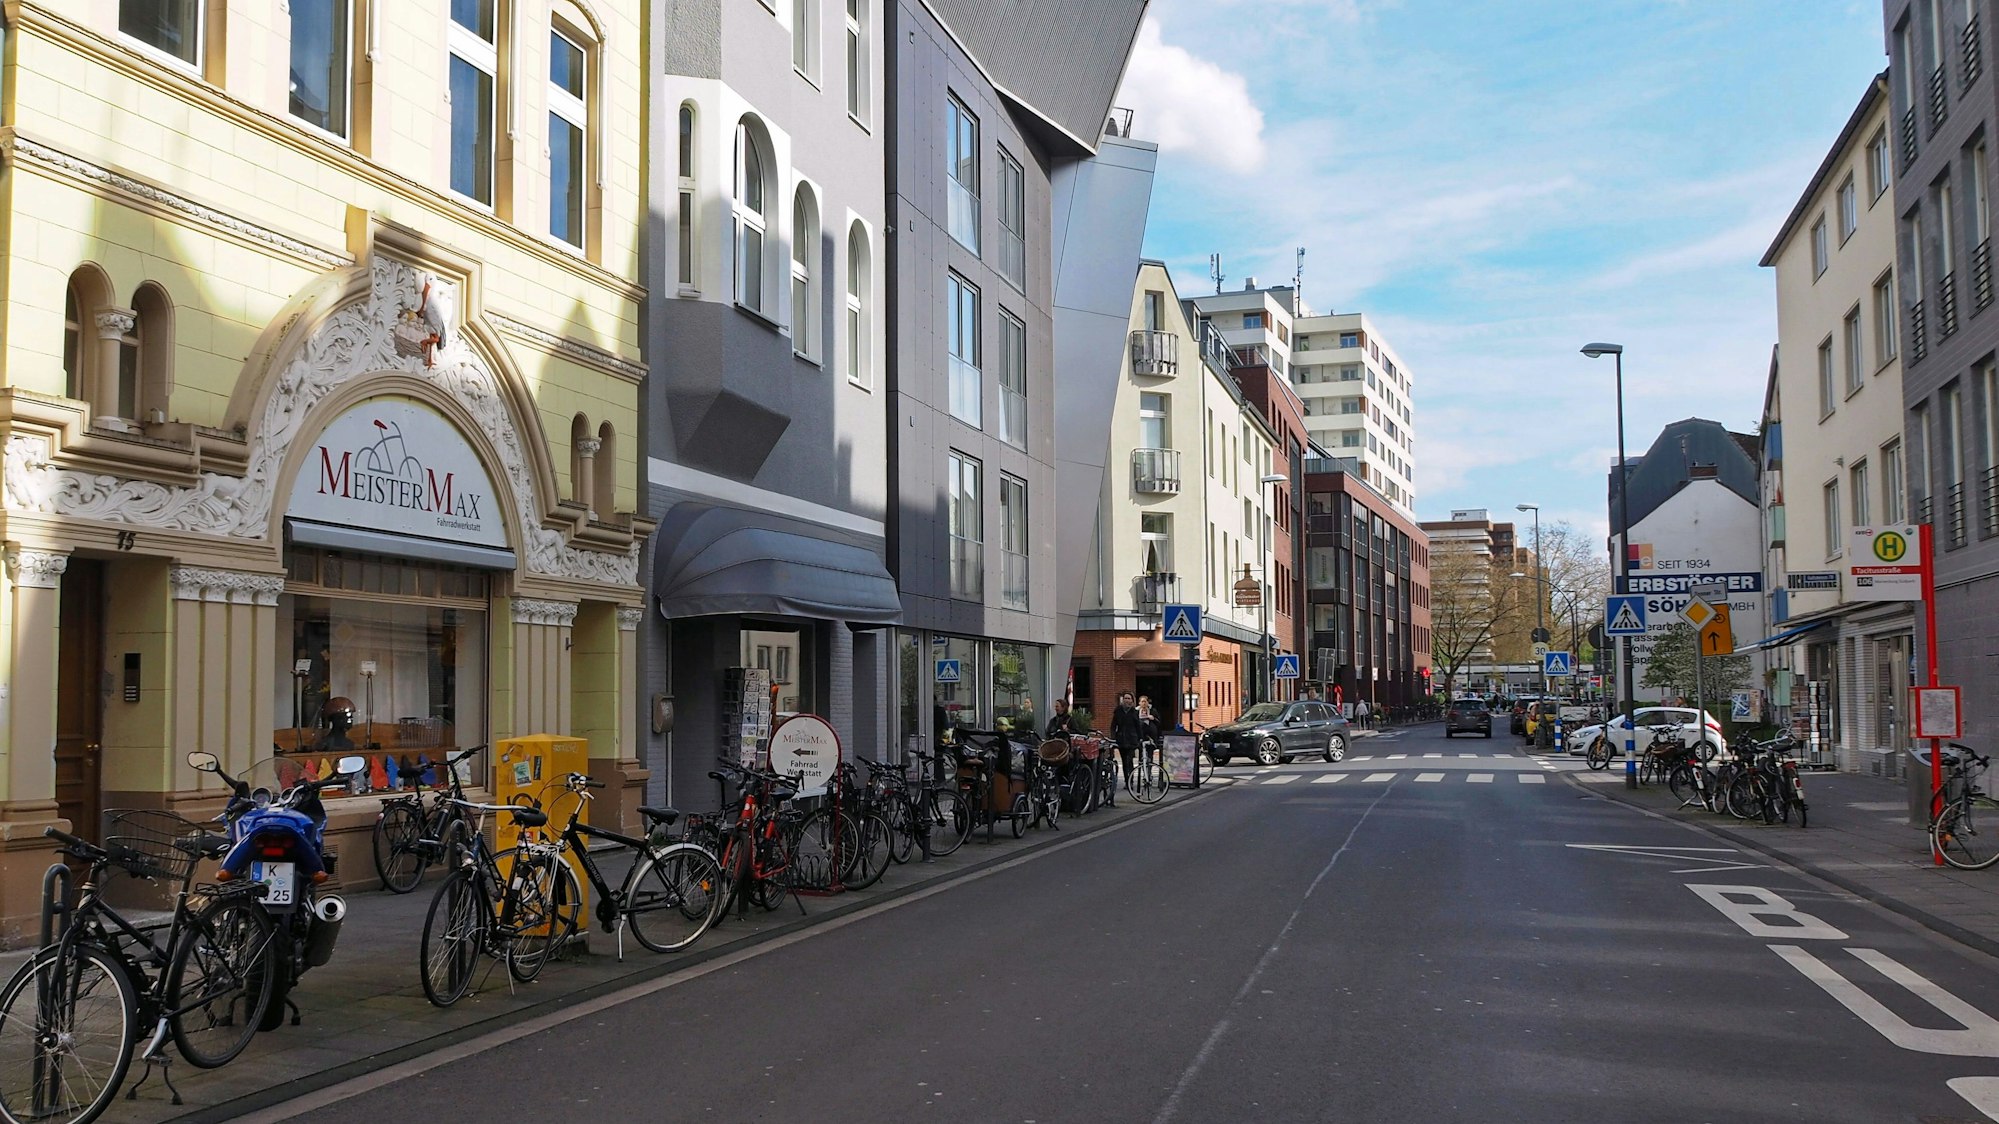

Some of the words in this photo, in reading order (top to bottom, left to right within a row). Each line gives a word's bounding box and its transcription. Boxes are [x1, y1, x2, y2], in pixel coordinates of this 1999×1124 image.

[436, 517, 481, 532] Fahrradwerkstatt
[1882, 537, 1898, 556] H
[1657, 560, 1682, 569] SEIT
[1686, 559, 1711, 568] 1934
[1857, 578, 1872, 586] 106
[1648, 596, 1686, 613] SÖH
[1728, 602, 1755, 611] MBH
[1534, 646, 1546, 655] 30
[790, 760, 819, 768] Fahrrad
[268, 864, 277, 876] K
